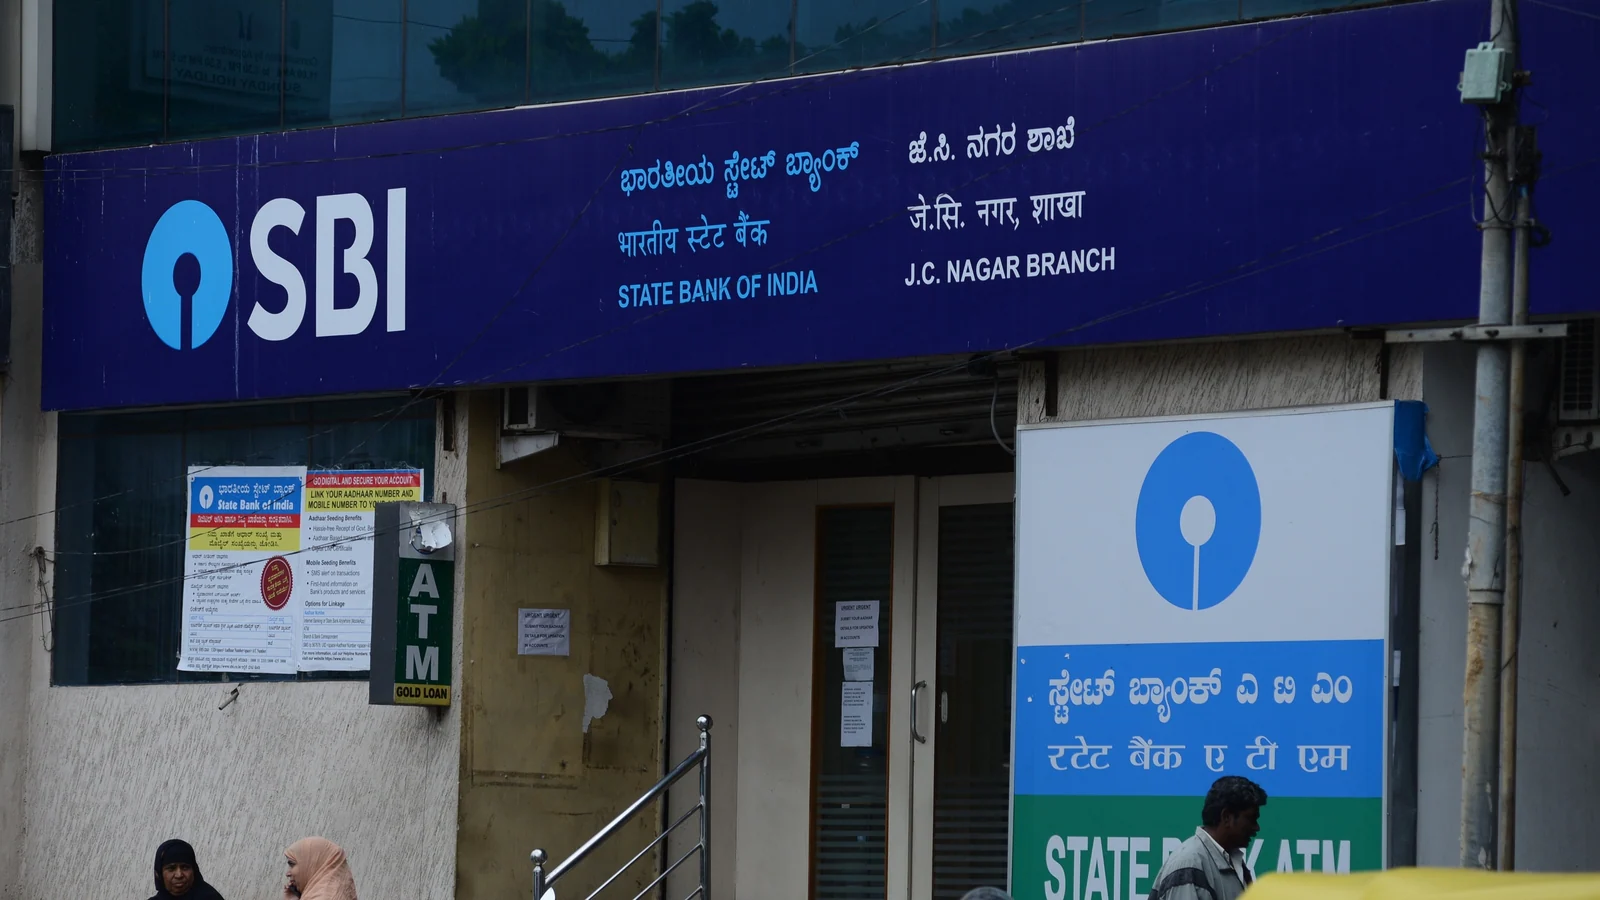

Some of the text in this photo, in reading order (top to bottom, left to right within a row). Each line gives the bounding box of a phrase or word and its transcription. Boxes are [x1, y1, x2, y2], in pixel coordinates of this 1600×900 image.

[908, 115, 1075, 164] ಜೆ.ಸಿ. ನಗರ ಶಾಖೆ
[620, 140, 860, 199] ಭಾರತೀಯ ಸ್ಟೇಟ್ ಬ್ಯಾಂಕ್
[906, 190, 1087, 232] जे.सि. नगर, शाखा
[617, 210, 771, 258] भारतीय स्टेट बैंक
[246, 188, 407, 341] SBI
[904, 246, 1115, 287] J.C. NAGAR BRANCH
[618, 269, 819, 309] STATE BANK OF INDIA
[313, 476, 413, 485] GO DIGITAL AND SECURE YOUR ACCOUNT
[326, 490, 342, 498] YOUR
[344, 490, 373, 498] AADHAAR
[375, 490, 400, 498] NUMBER
[218, 500, 237, 510] State
[240, 500, 260, 510] Bank
[262, 500, 271, 510] of
[308, 501, 330, 509] MOBILE
[406, 563, 440, 681] ATM
[396, 686, 447, 700] GOLD LOAN
[1048, 668, 1115, 725] ಸ್ಟೇಟ್
[1128, 667, 1222, 724] ಬ್ಯಾಂಕ್
[1273, 675, 1296, 704] ಟಿ
[1127, 735, 1186, 770] बैंक
[1203, 744, 1229, 773] ए
[1245, 735, 1279, 770] टी
[1296, 745, 1352, 773] एम
[1044, 834, 1150, 900] STATE
